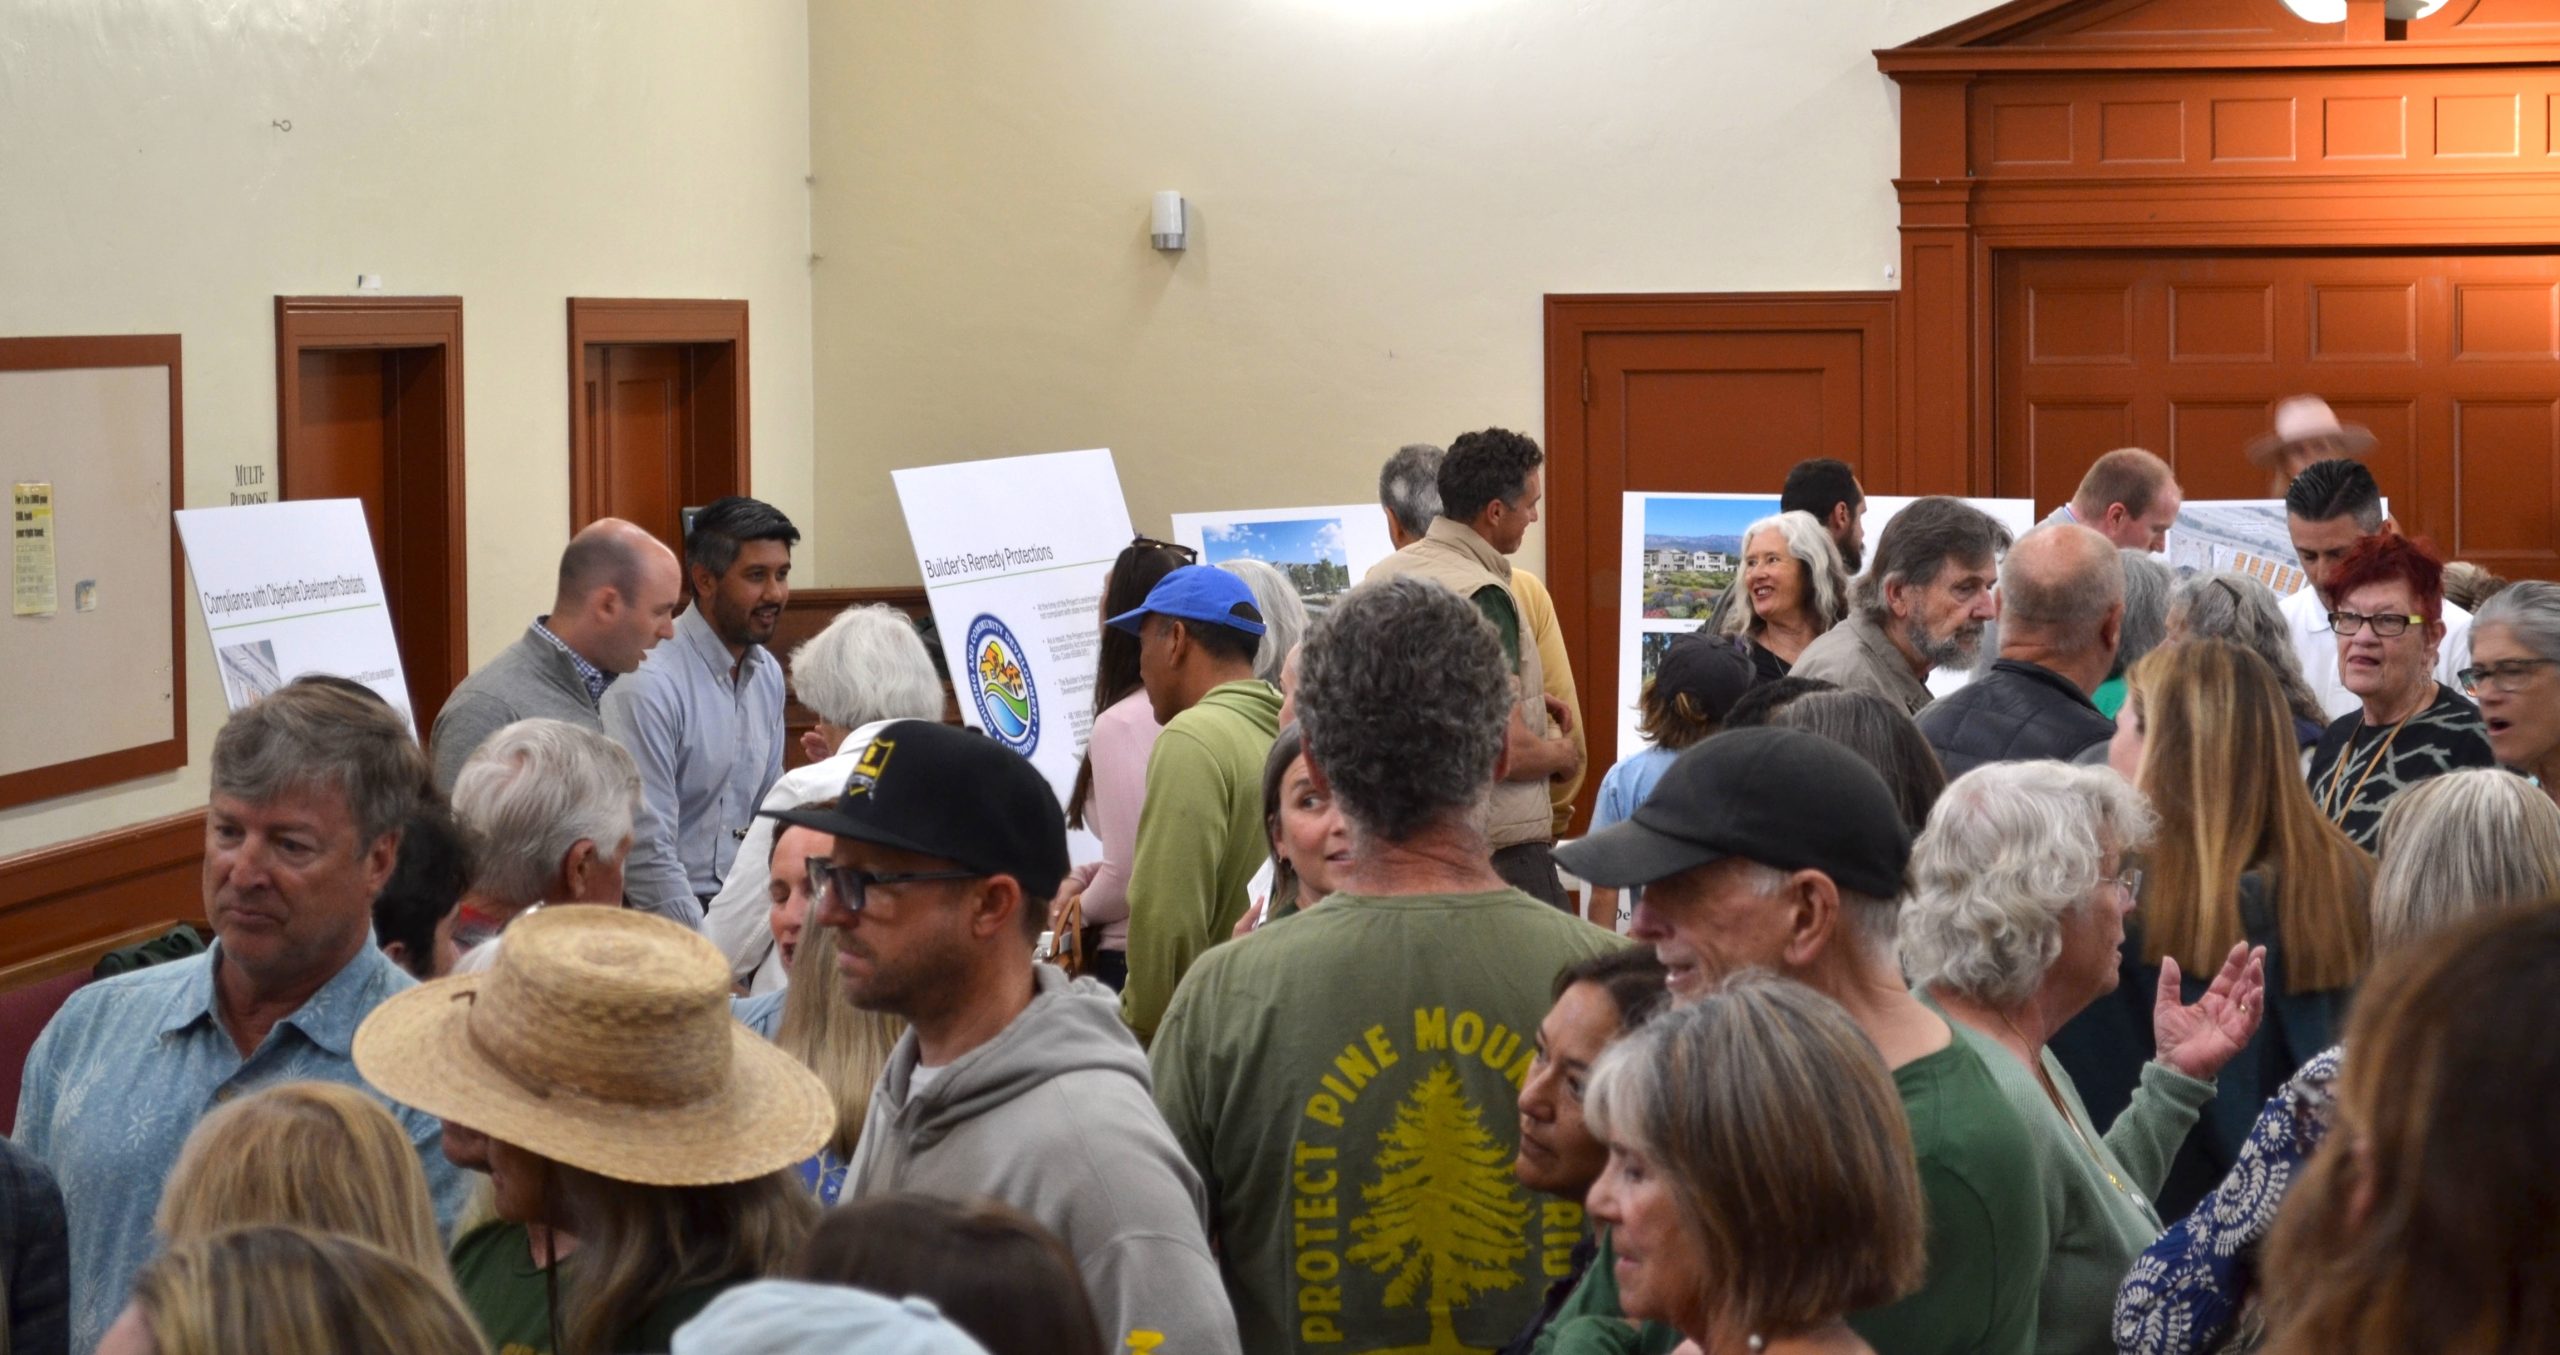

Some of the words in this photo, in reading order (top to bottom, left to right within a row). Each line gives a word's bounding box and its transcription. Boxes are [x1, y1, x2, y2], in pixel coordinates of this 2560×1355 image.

[925, 555, 968, 579] Builder's
[966, 550, 1006, 571] Remedy
[1004, 543, 1054, 566] Protections
[203, 588, 252, 617] Compliance
[250, 585, 268, 608] with
[266, 581, 301, 610] Objective
[298, 576, 340, 603] Development
[336, 573, 367, 596] Standards
[968, 645, 976, 671] AND
[969, 619, 1004, 644] COMMUNITY
[970, 673, 995, 733] HOUSING
[1004, 631, 1038, 724] DEVELOPMENT
[1305, 1023, 1399, 1128] PINE
[1414, 1006, 1538, 1090] MOUN
[1294, 1140, 1344, 1343] PROTECT
